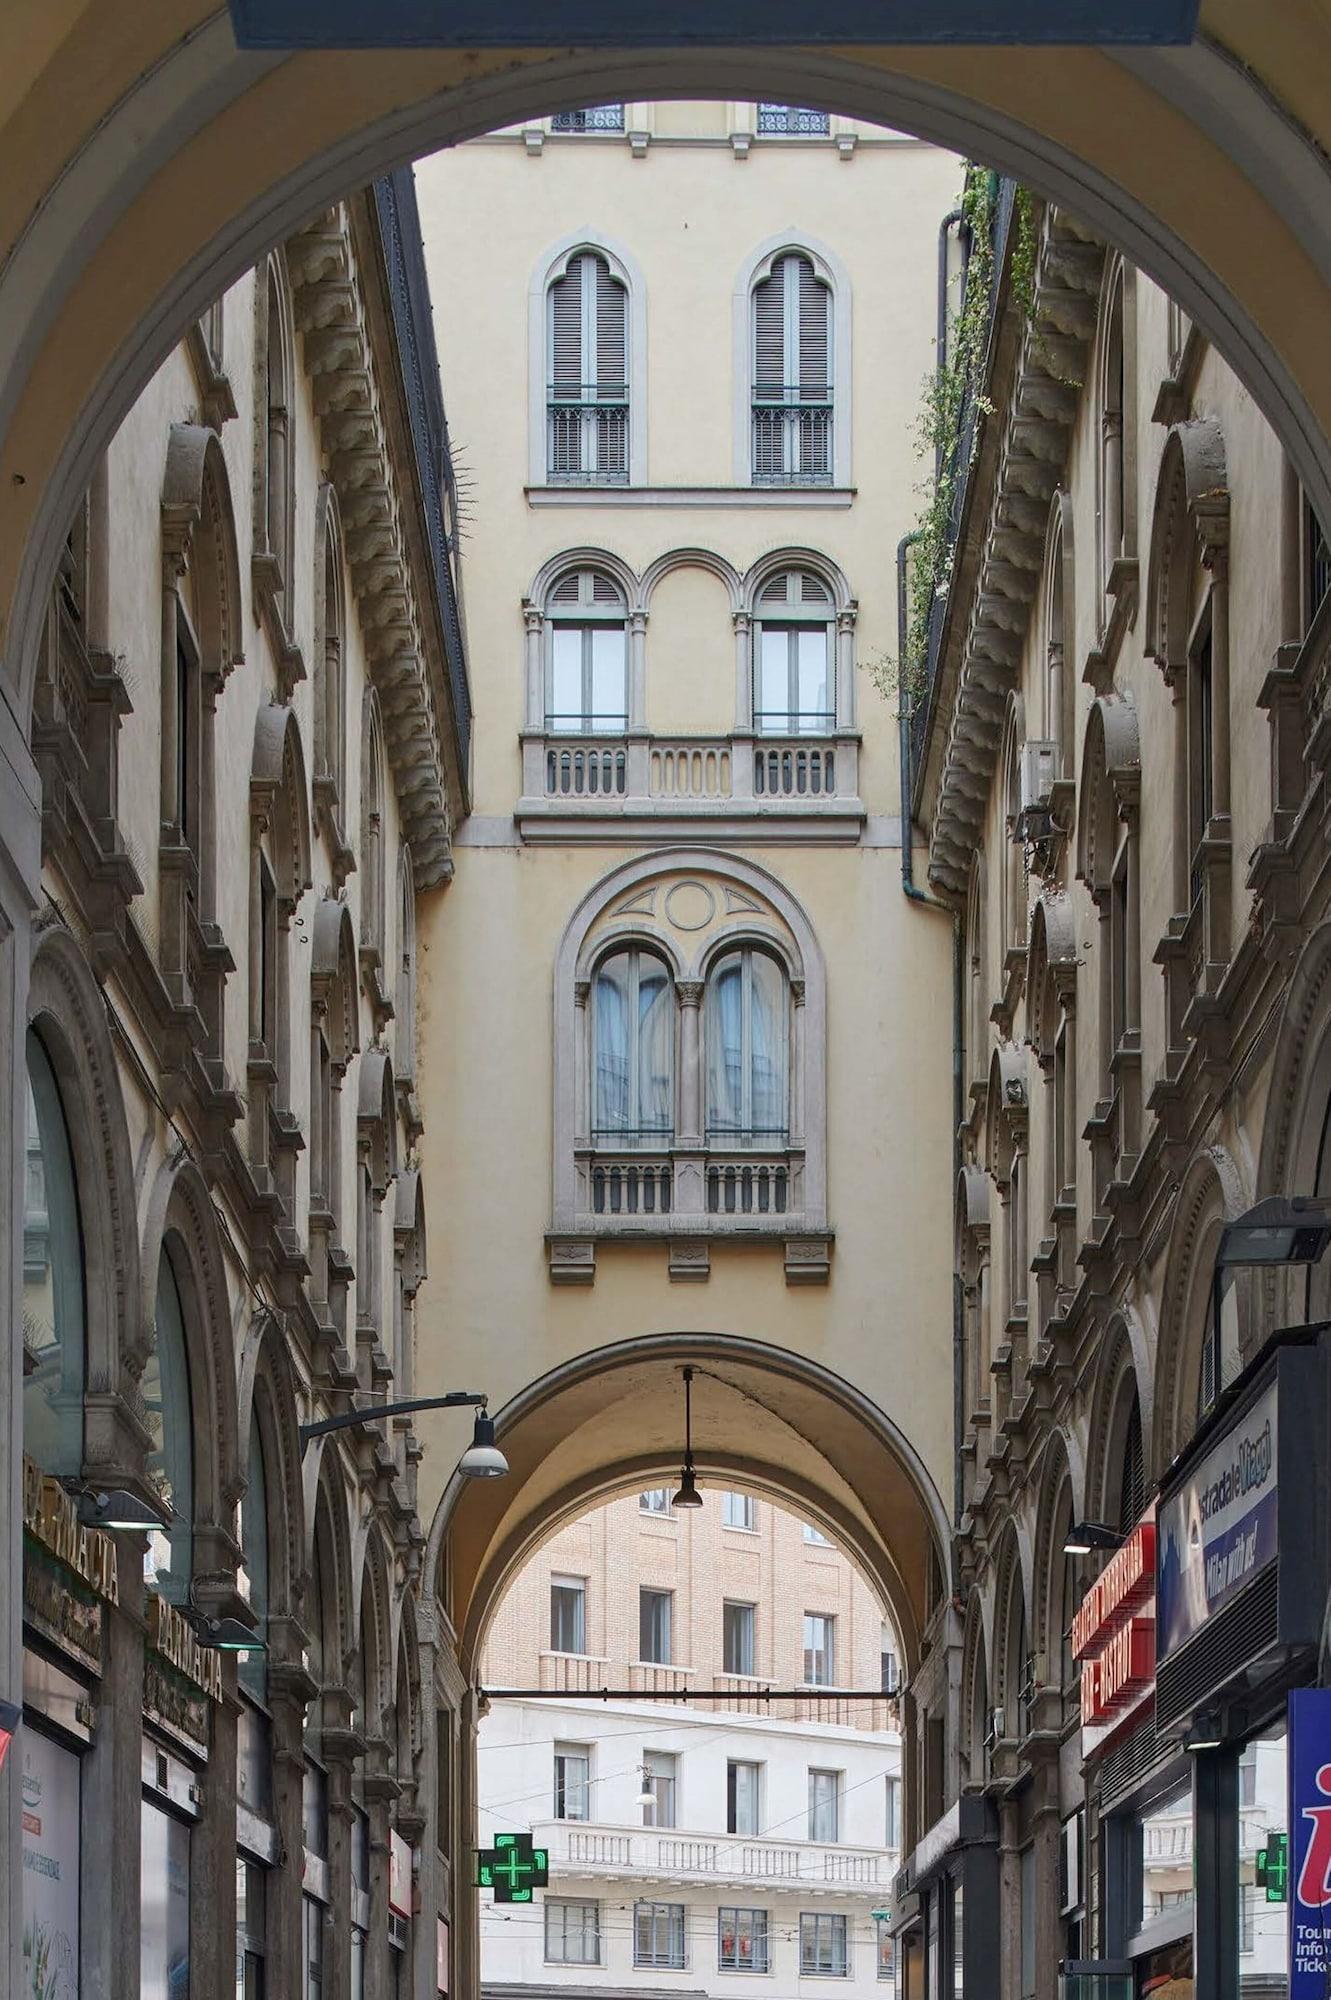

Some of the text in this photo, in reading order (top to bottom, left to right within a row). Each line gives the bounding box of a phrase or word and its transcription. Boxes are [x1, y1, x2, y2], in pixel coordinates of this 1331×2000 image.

[1206, 1552, 1227, 1600] Milan
[1227, 1532, 1245, 1589] with
[1100, 1615, 1134, 1709] BISTROT
[1296, 1941, 1328, 1956] Info
